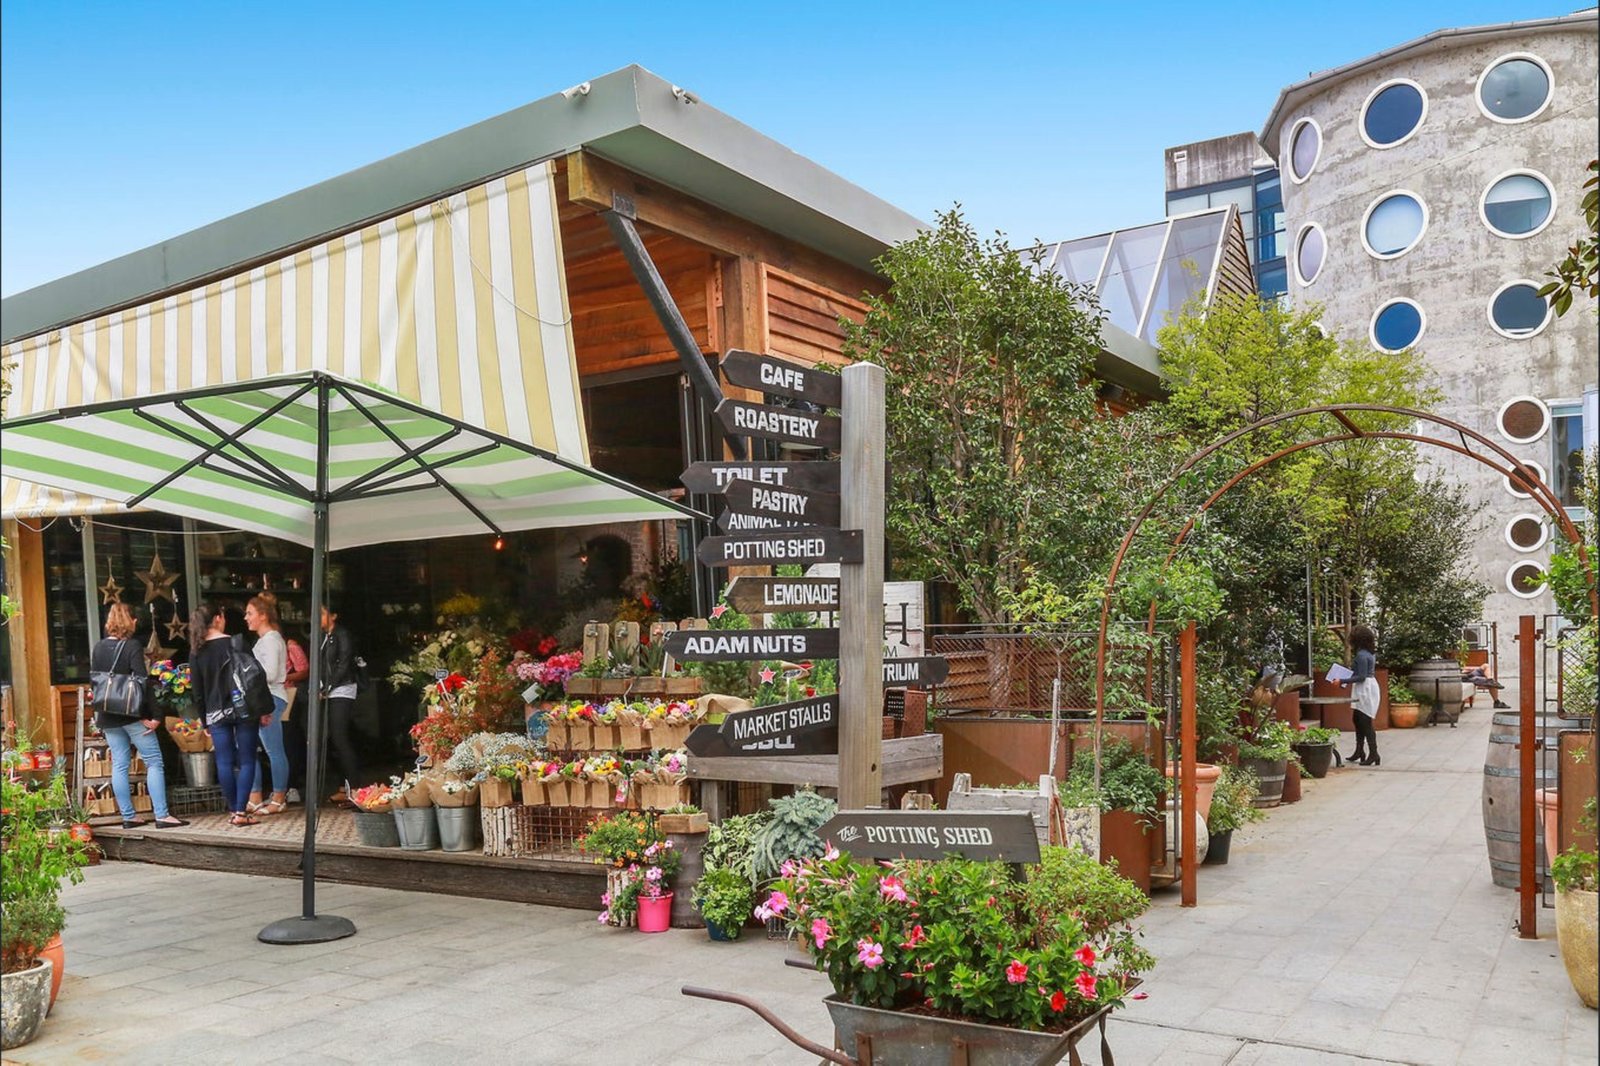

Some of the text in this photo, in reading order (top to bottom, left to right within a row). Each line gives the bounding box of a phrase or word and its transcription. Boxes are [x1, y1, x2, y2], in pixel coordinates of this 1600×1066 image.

[760, 362, 804, 392] CAFE
[734, 406, 819, 438] ROASTERY
[752, 487, 809, 516] PASTRY
[724, 538, 825, 560] POTTING SHED
[764, 583, 838, 606] LEMONADE
[684, 635, 806, 655] ADAM NUTS
[882, 662, 919, 682] TRIUM
[734, 702, 831, 740] MARKET STALLS
[837, 825, 993, 849] The POTTING SHED
